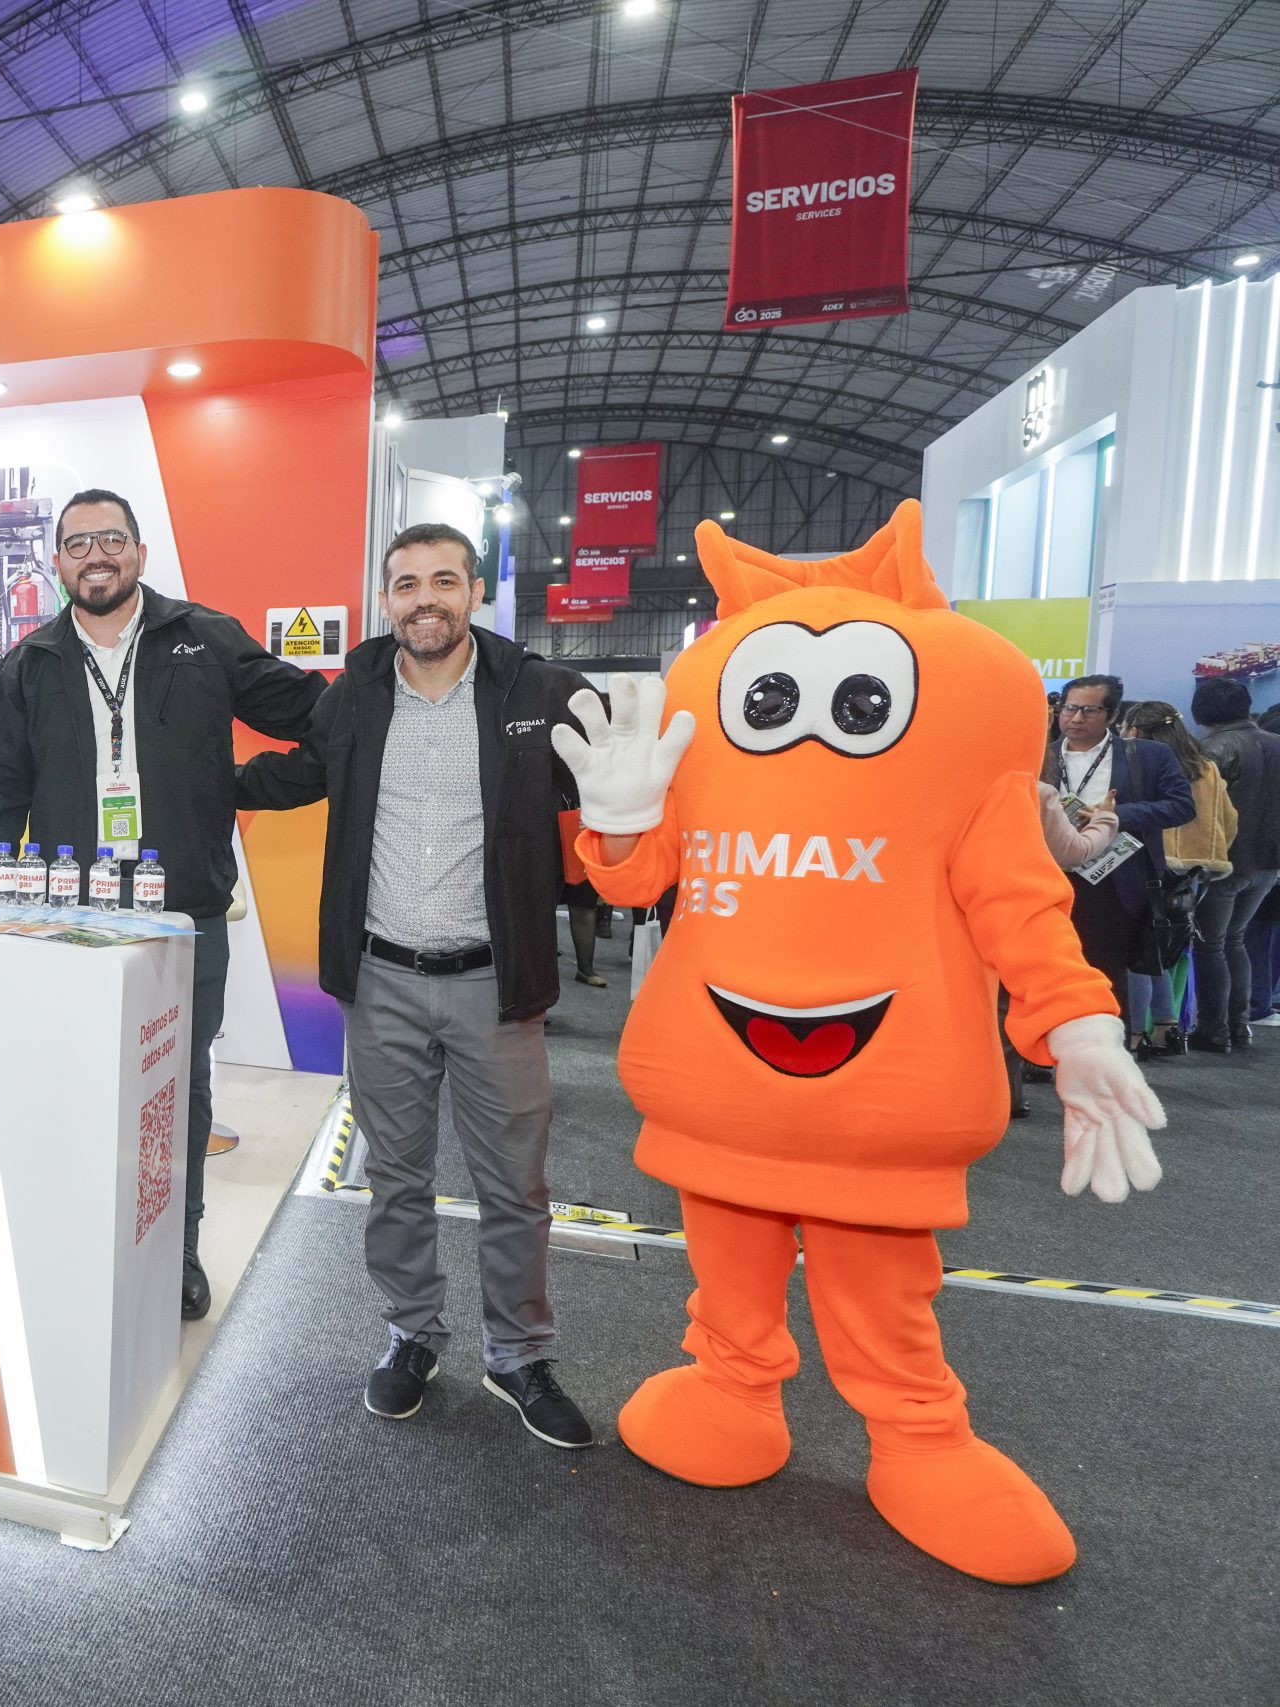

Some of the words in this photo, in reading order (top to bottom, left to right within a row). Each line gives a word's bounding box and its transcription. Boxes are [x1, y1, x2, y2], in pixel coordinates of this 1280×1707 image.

[746, 173, 896, 213] SERVICIOS
[796, 208, 842, 222] SERVICES
[822, 303, 844, 312] ADEX
[760, 310, 782, 320] 2025
[584, 490, 653, 504] SERVICIOS
[576, 557, 625, 567] SERVICIOS
[516, 718, 546, 727] PRIMAX
[57, 884, 73, 892] gas
[143, 889, 159, 897] gas
[140, 1013, 167, 1046] Déjanos
[168, 1005, 179, 1023] tus
[141, 1046, 161, 1074] datos
[162, 1028, 176, 1057] aquí
